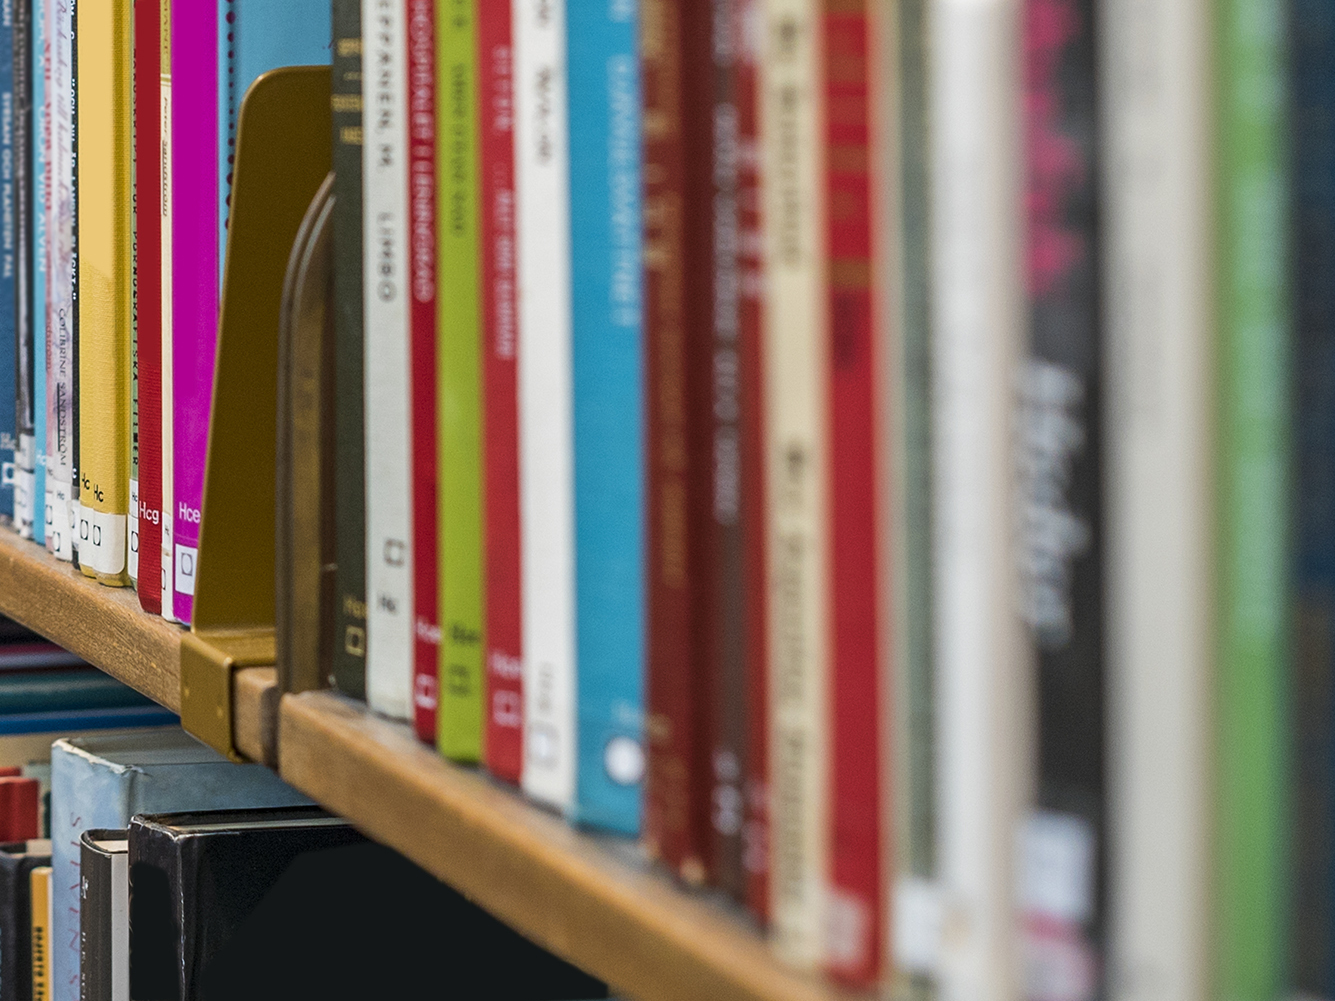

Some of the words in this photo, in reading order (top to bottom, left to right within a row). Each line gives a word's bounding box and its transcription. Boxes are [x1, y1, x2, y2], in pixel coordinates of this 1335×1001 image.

[3, 147, 13, 181] OCH
[58, 308, 68, 378] COLIBRINE
[57, 382, 69, 467] SANDSTRÖM
[94, 484, 104, 503] Hc
[139, 500, 160, 525] Hcg
[179, 501, 201, 524] Hce
